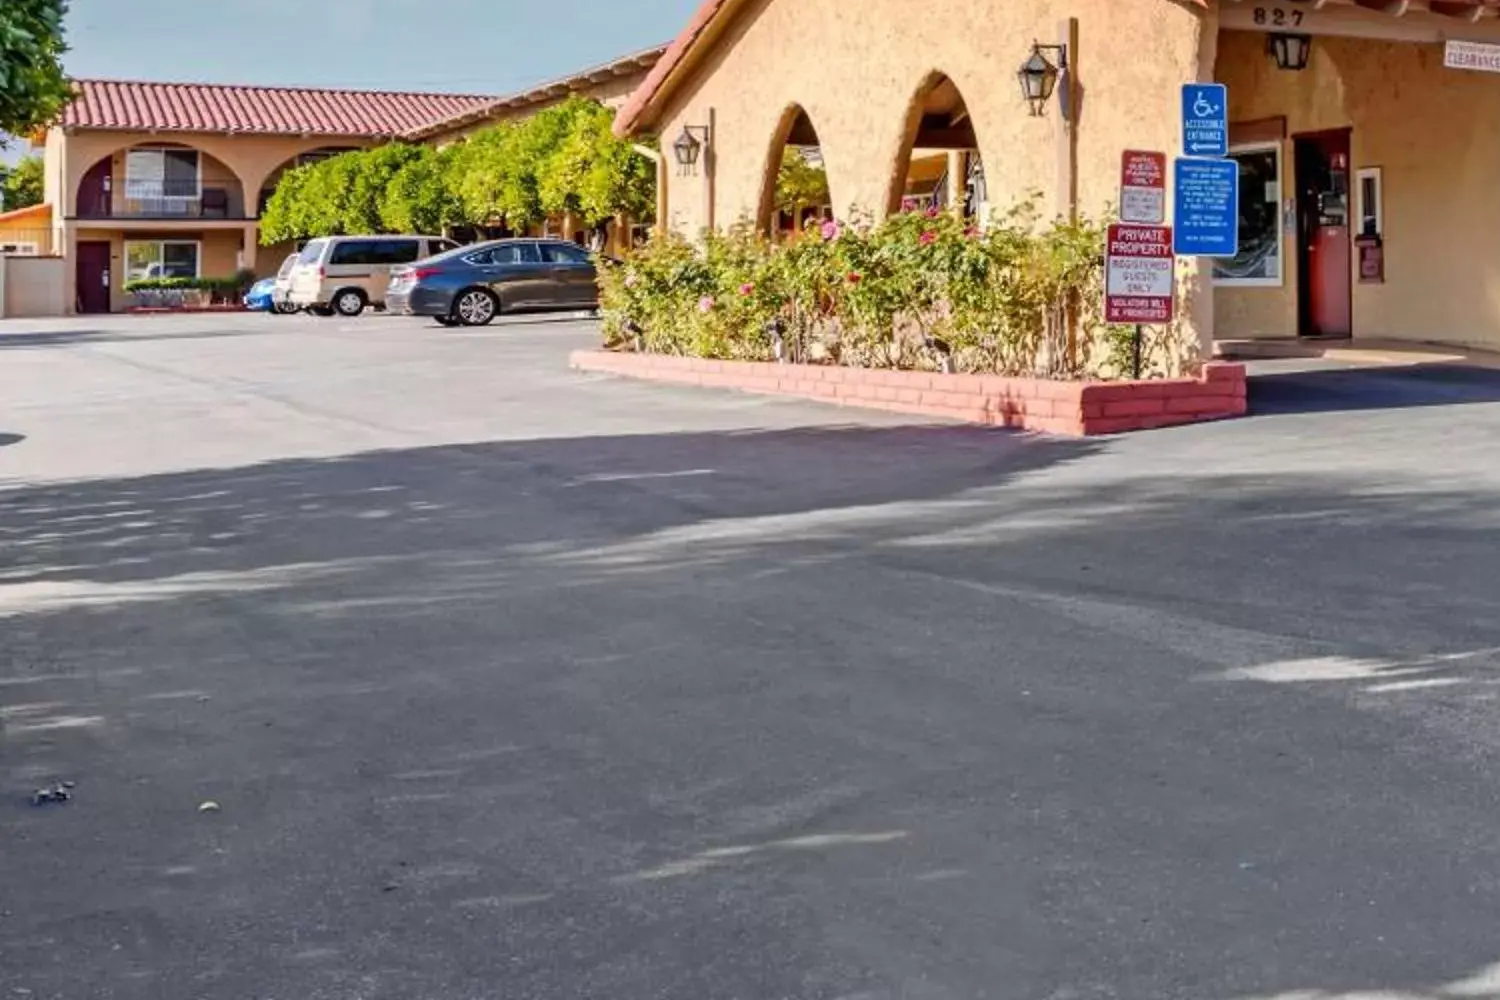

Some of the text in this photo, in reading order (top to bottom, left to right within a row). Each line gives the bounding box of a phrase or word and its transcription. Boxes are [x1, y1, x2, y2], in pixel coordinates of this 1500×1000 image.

[1253, 6, 1304, 27] 827
[1448, 52, 1500, 68] CLEARANCE
[1185, 119, 1224, 129] ACCESSIBLE
[1187, 130, 1222, 141] ENTRANCE
[1117, 228, 1165, 242] PRIVATE
[1111, 241, 1170, 255] PROPERTY
[1112, 259, 1169, 271] REGISTERED
[1122, 271, 1158, 282] GUESTS
[1127, 283, 1152, 293] ONLY
[1151, 299, 1166, 308] WILL
